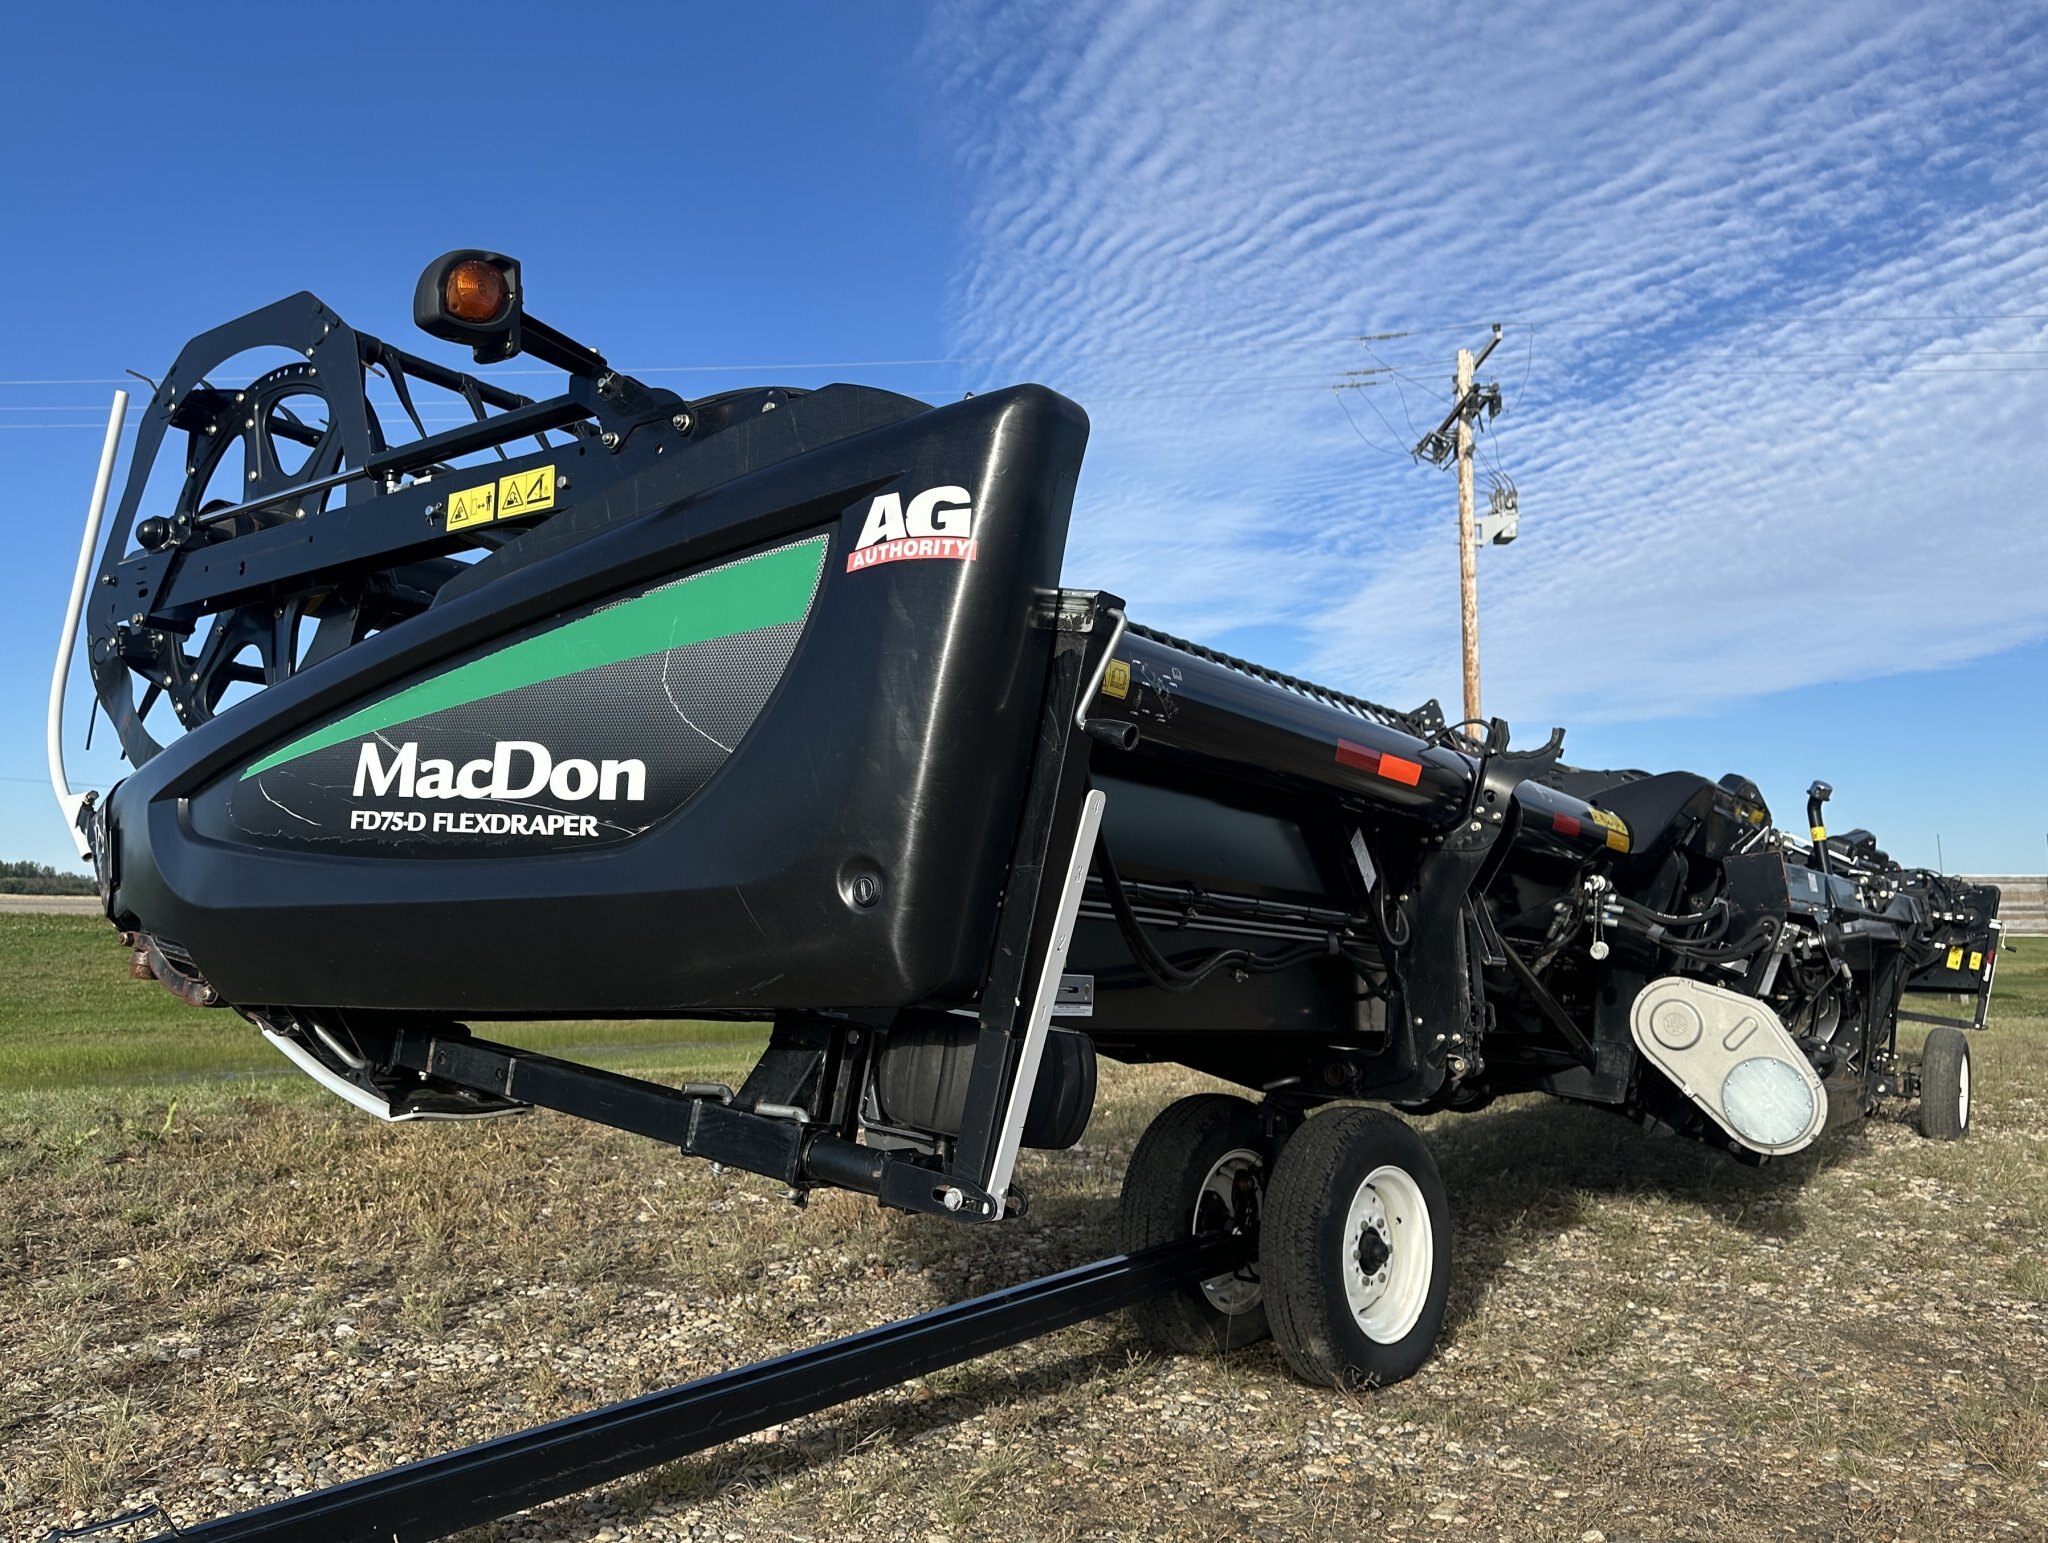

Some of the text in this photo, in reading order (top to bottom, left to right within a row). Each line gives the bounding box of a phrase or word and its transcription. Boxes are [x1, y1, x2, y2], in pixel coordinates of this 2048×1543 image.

[855, 485, 972, 551] AG
[852, 539, 971, 569] AUTHORITY
[352, 741, 646, 801] MacDon
[1092, 799, 1101, 815] 4
[432, 812, 600, 837] FLEXDRAPER
[1075, 865, 1084, 884] 3
[1057, 934, 1067, 952] 2
[1041, 1004, 1048, 1021] 1
